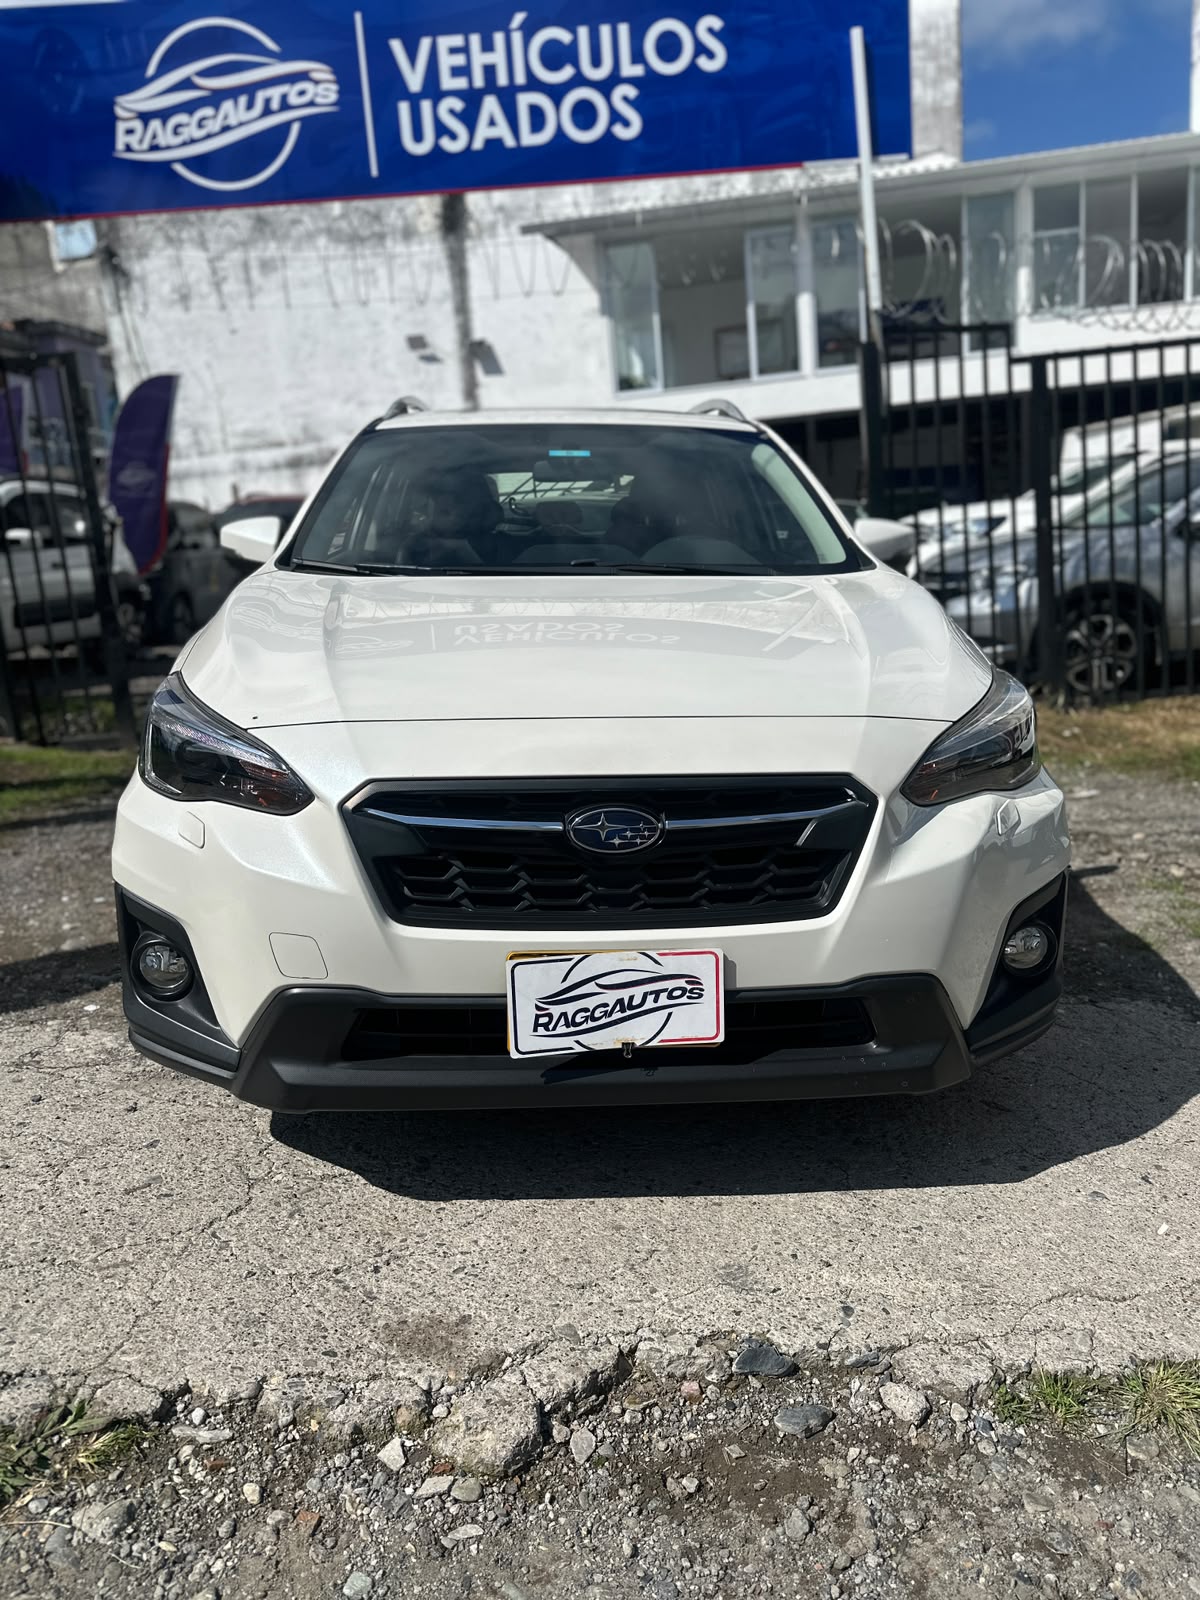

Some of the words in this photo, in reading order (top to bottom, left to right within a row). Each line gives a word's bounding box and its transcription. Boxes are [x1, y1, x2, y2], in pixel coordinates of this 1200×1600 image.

[389, 12, 727, 93] VEHÍCULOS
[115, 79, 339, 153] RAGGAUTOS
[398, 84, 643, 156] USADOS
[532, 986, 705, 1033] RAGGAUTOS
